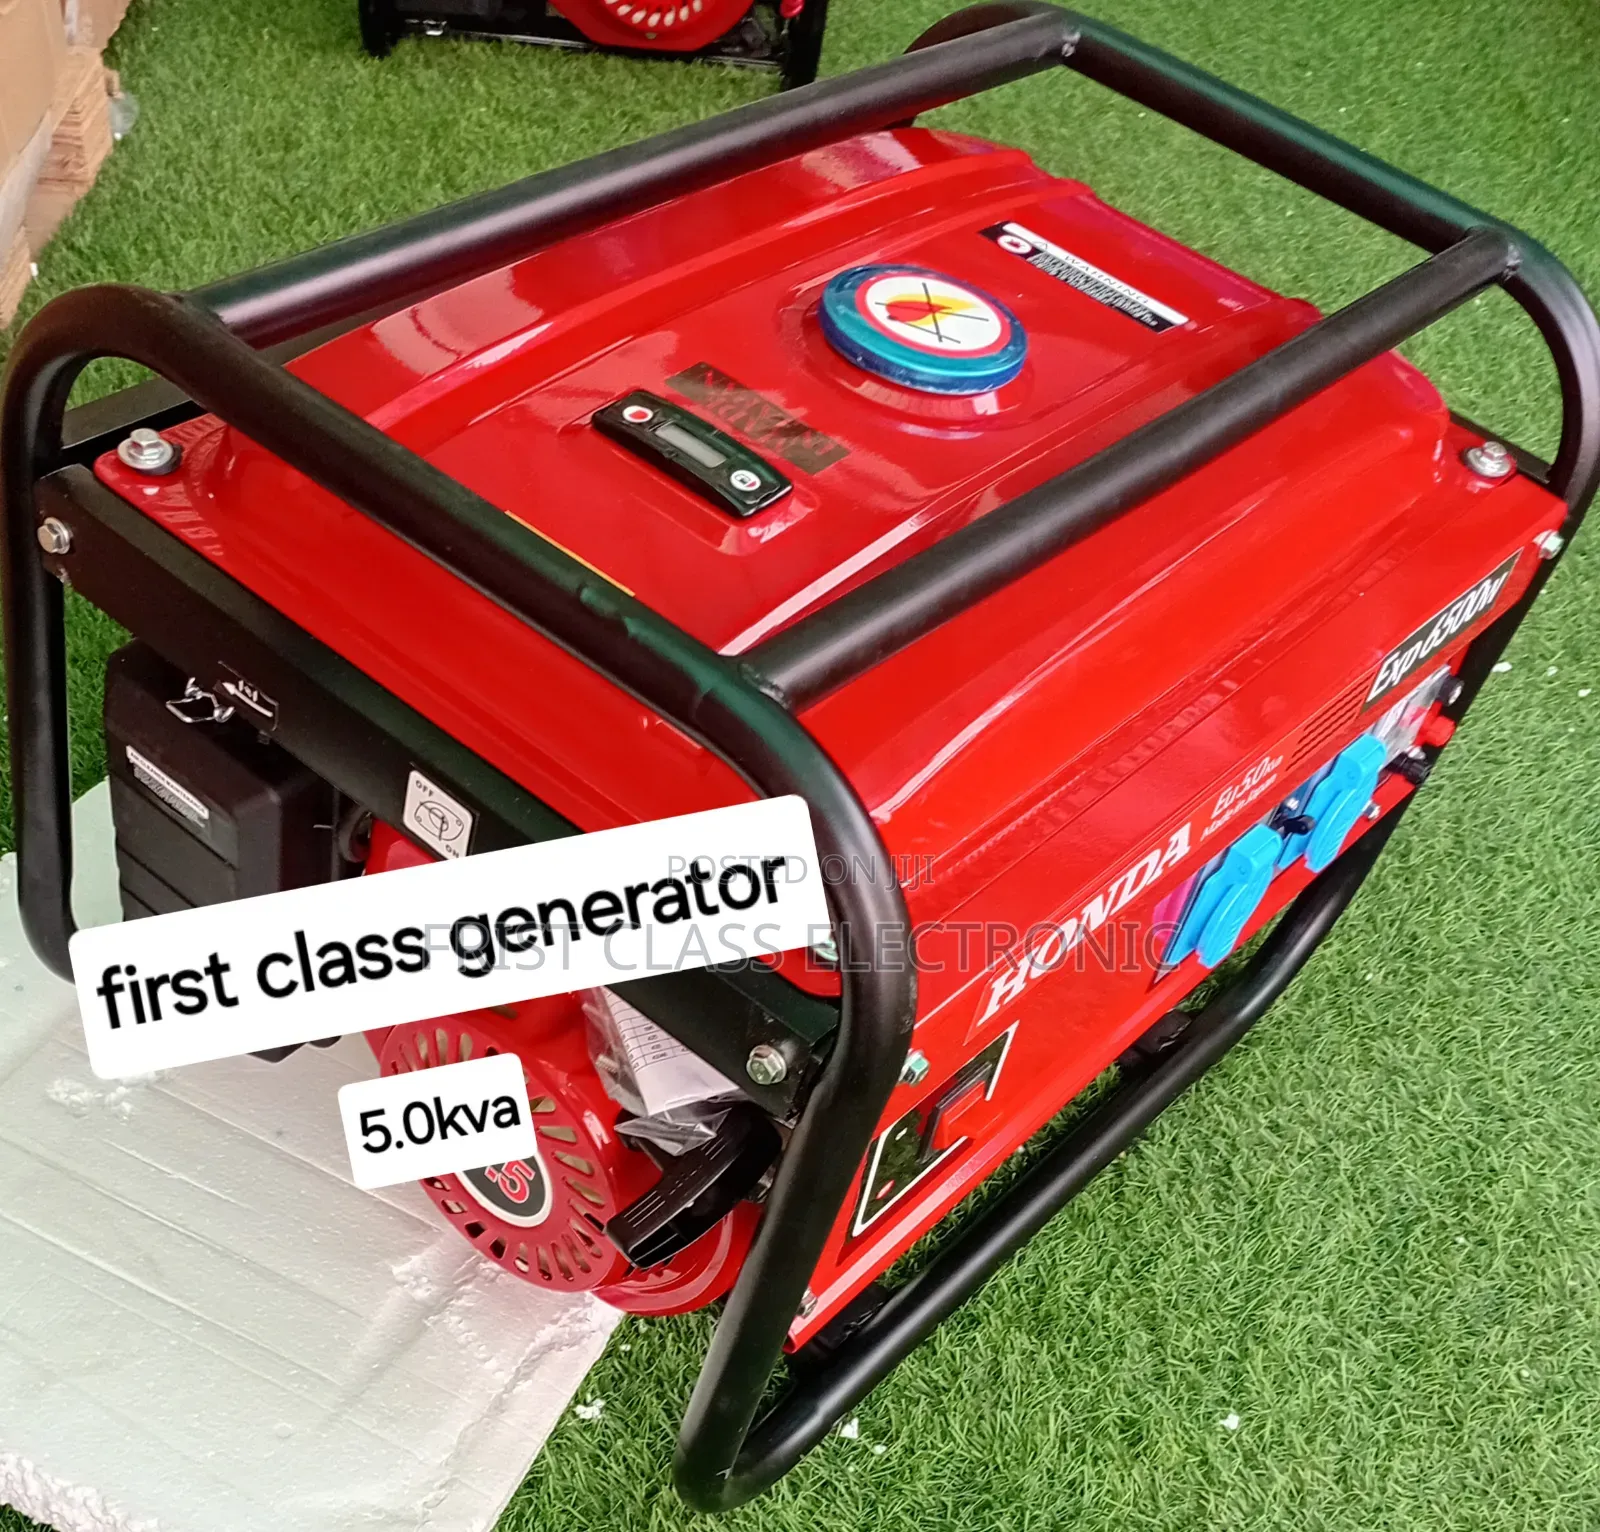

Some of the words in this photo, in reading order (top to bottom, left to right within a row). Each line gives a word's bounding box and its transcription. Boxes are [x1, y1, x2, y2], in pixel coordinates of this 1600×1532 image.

[1065, 255, 1149, 304] WARNING
[415, 780, 435, 797] OFF
[445, 844, 459, 859] ON
[976, 822, 1192, 1026] HONDA
